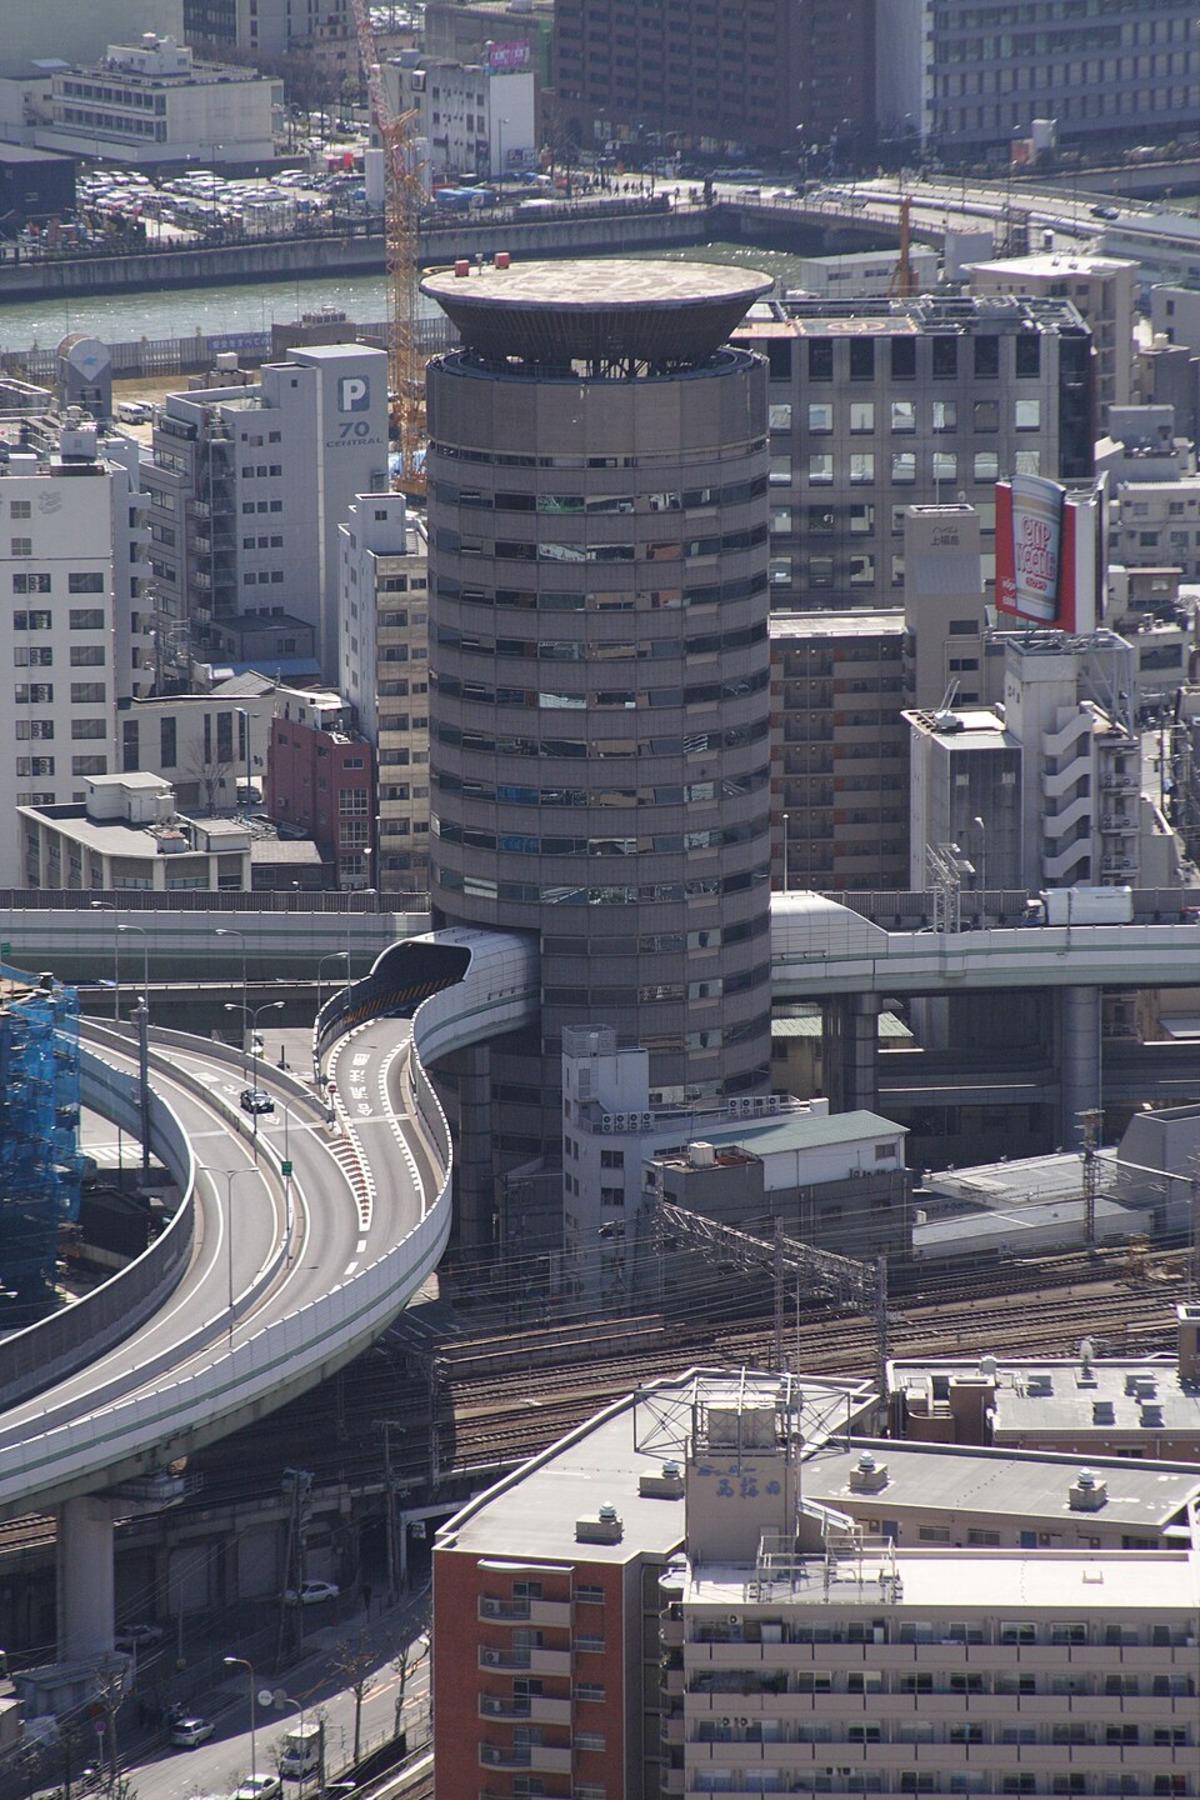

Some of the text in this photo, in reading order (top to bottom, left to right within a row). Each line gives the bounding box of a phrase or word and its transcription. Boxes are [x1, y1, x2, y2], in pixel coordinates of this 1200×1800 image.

[343, 378, 366, 411] P
[338, 421, 370, 438] 70
[326, 437, 383, 448] CENTRAL
